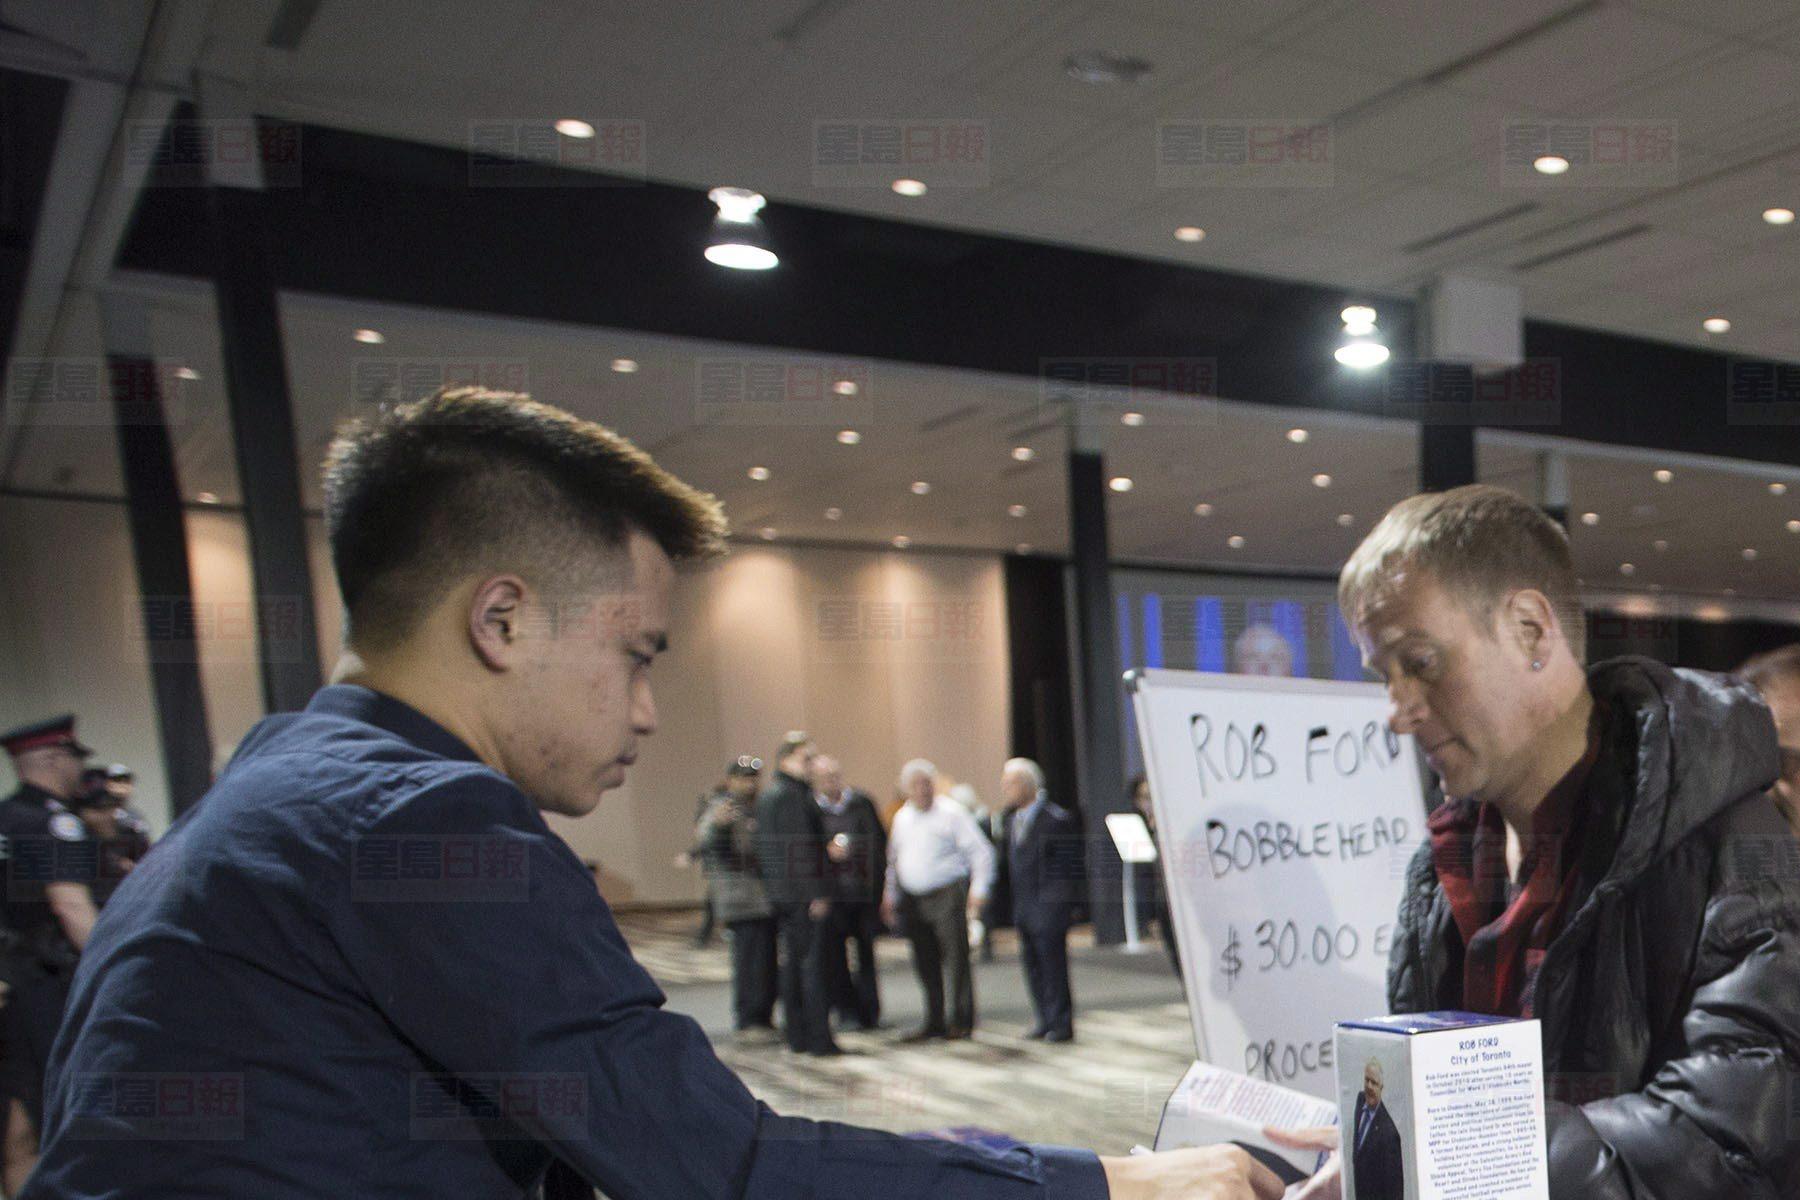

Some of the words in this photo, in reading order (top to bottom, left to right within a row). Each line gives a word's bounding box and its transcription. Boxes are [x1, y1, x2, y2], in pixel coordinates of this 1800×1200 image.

[1190, 713, 1276, 798] ROB
[1306, 720, 1400, 783] FORD
[1206, 817, 1408, 879] BOBBLEHEAD
[1451, 1054, 1468, 1067] City
[1470, 1053, 1478, 1064] of
[1481, 1048, 1511, 1062] Toronto
[1459, 1039, 1475, 1051] ROB
[1478, 1036, 1498, 1048] FORD
